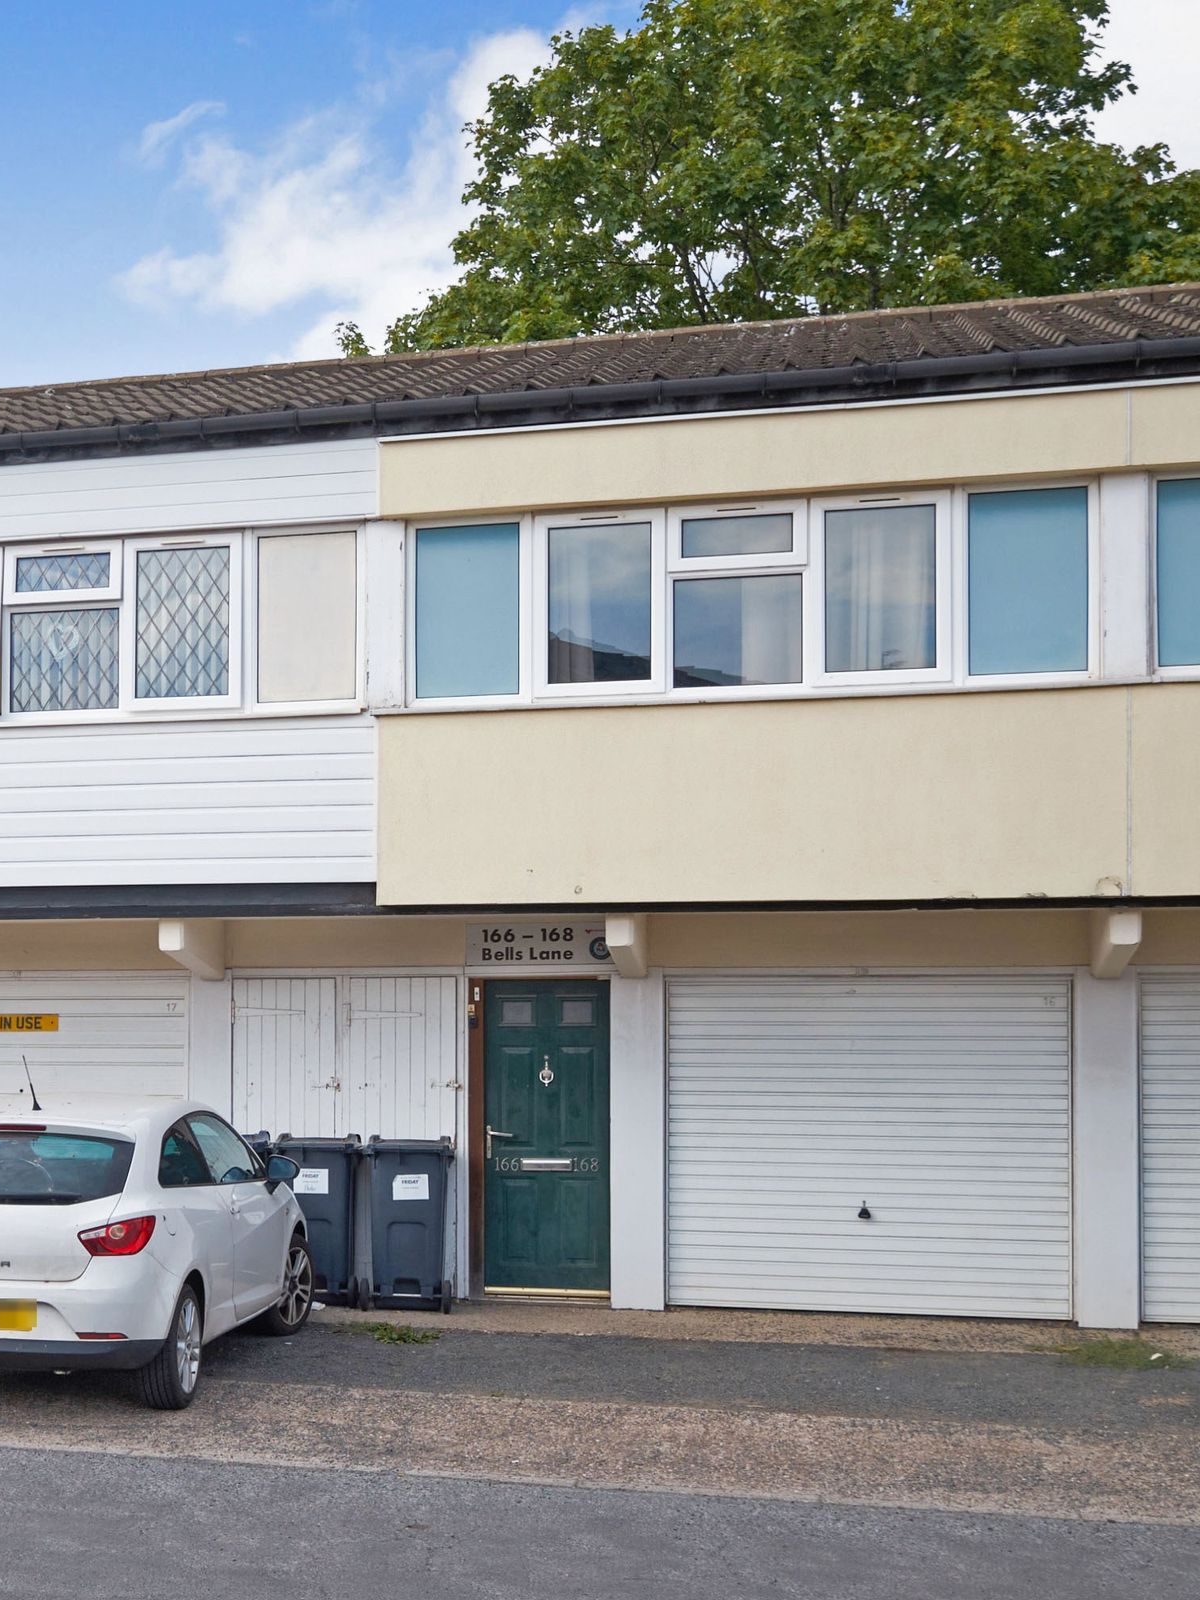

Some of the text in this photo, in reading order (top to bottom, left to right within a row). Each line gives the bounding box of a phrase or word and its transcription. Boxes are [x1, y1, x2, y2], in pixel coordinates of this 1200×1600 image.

[482, 928, 516, 943] 166
[540, 927, 574, 942] 168
[481, 946, 524, 961] Bells
[529, 947, 574, 960] Lane
[166, 1002, 177, 1012] 17
[0, 1016, 43, 1029] IN USE
[494, 1157, 599, 1172] 166 168
